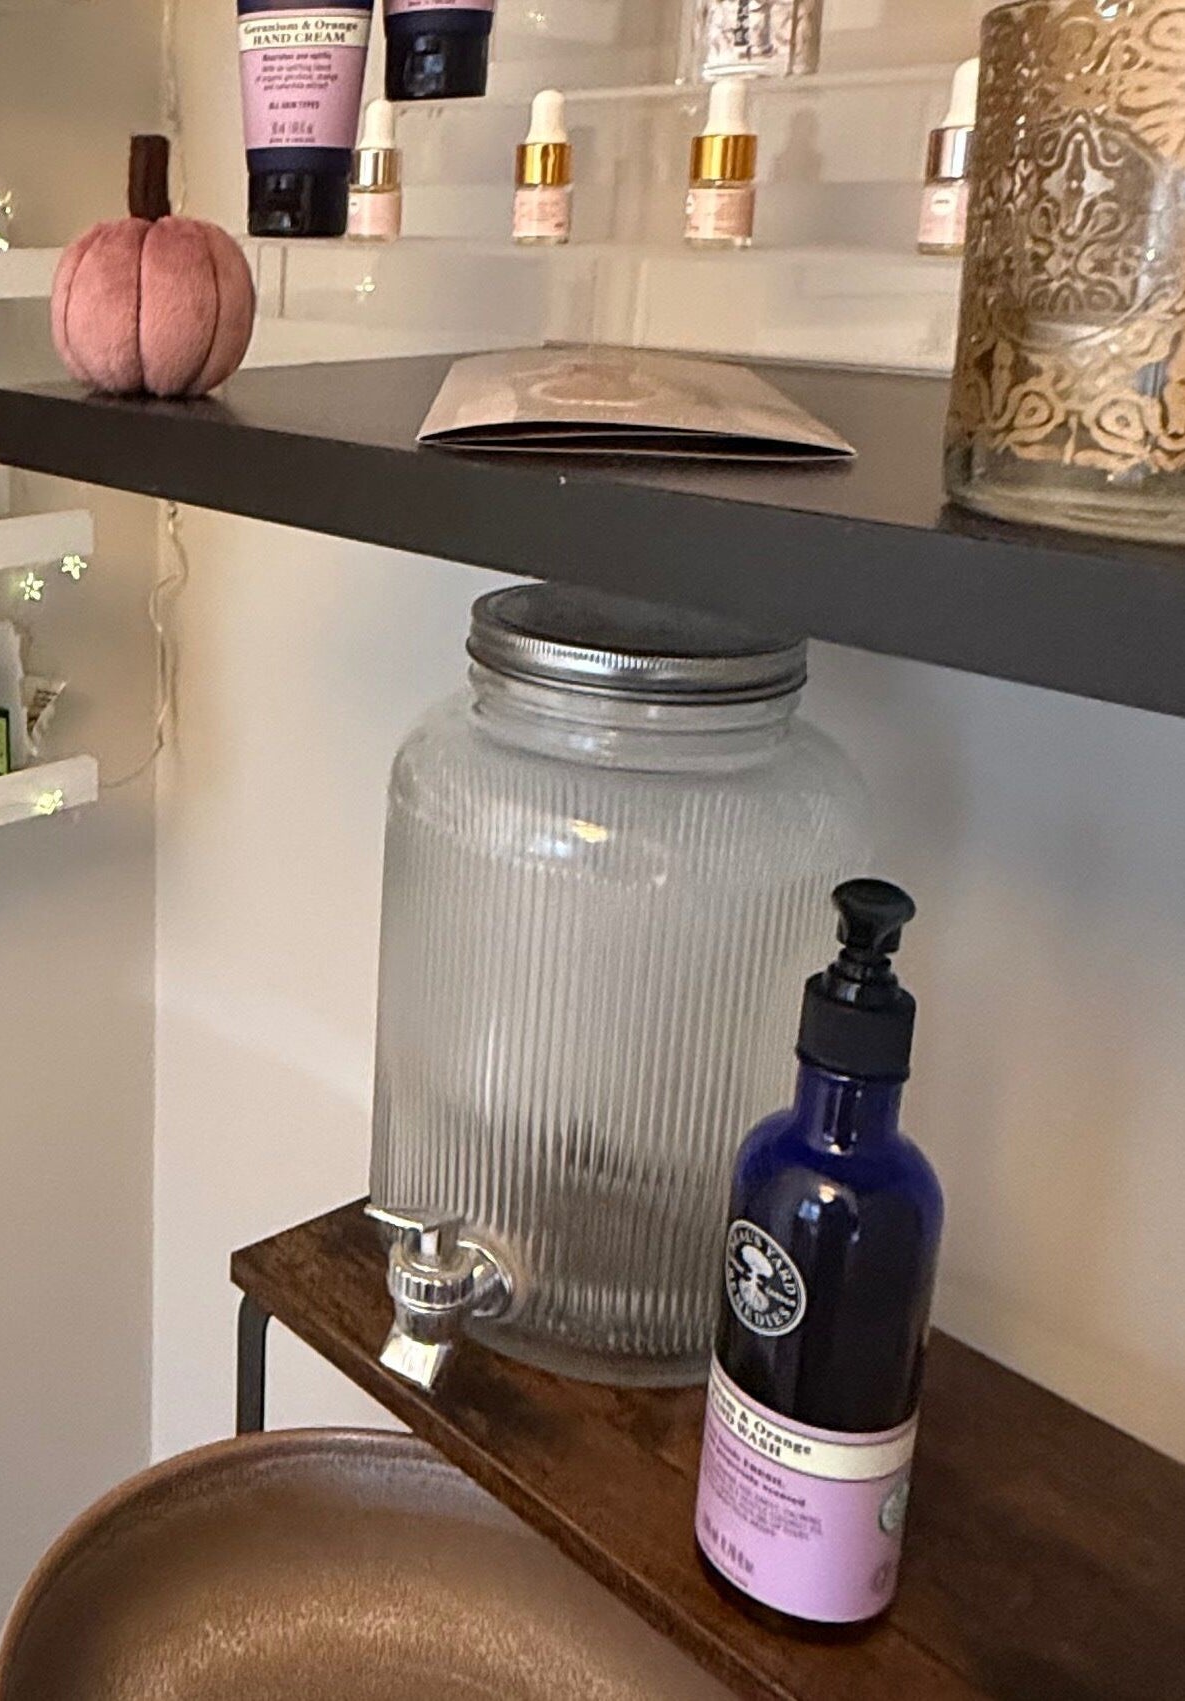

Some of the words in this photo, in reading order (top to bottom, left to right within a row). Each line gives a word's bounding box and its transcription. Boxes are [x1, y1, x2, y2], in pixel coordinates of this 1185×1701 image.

[301, 20, 311, 31] &
[314, 18, 358, 32] Orange
[253, 33, 291, 46] HAND
[294, 31, 346, 43] CREAM
[736, 1420, 781, 1457] WASH
[753, 1420, 812, 1456] Orange
